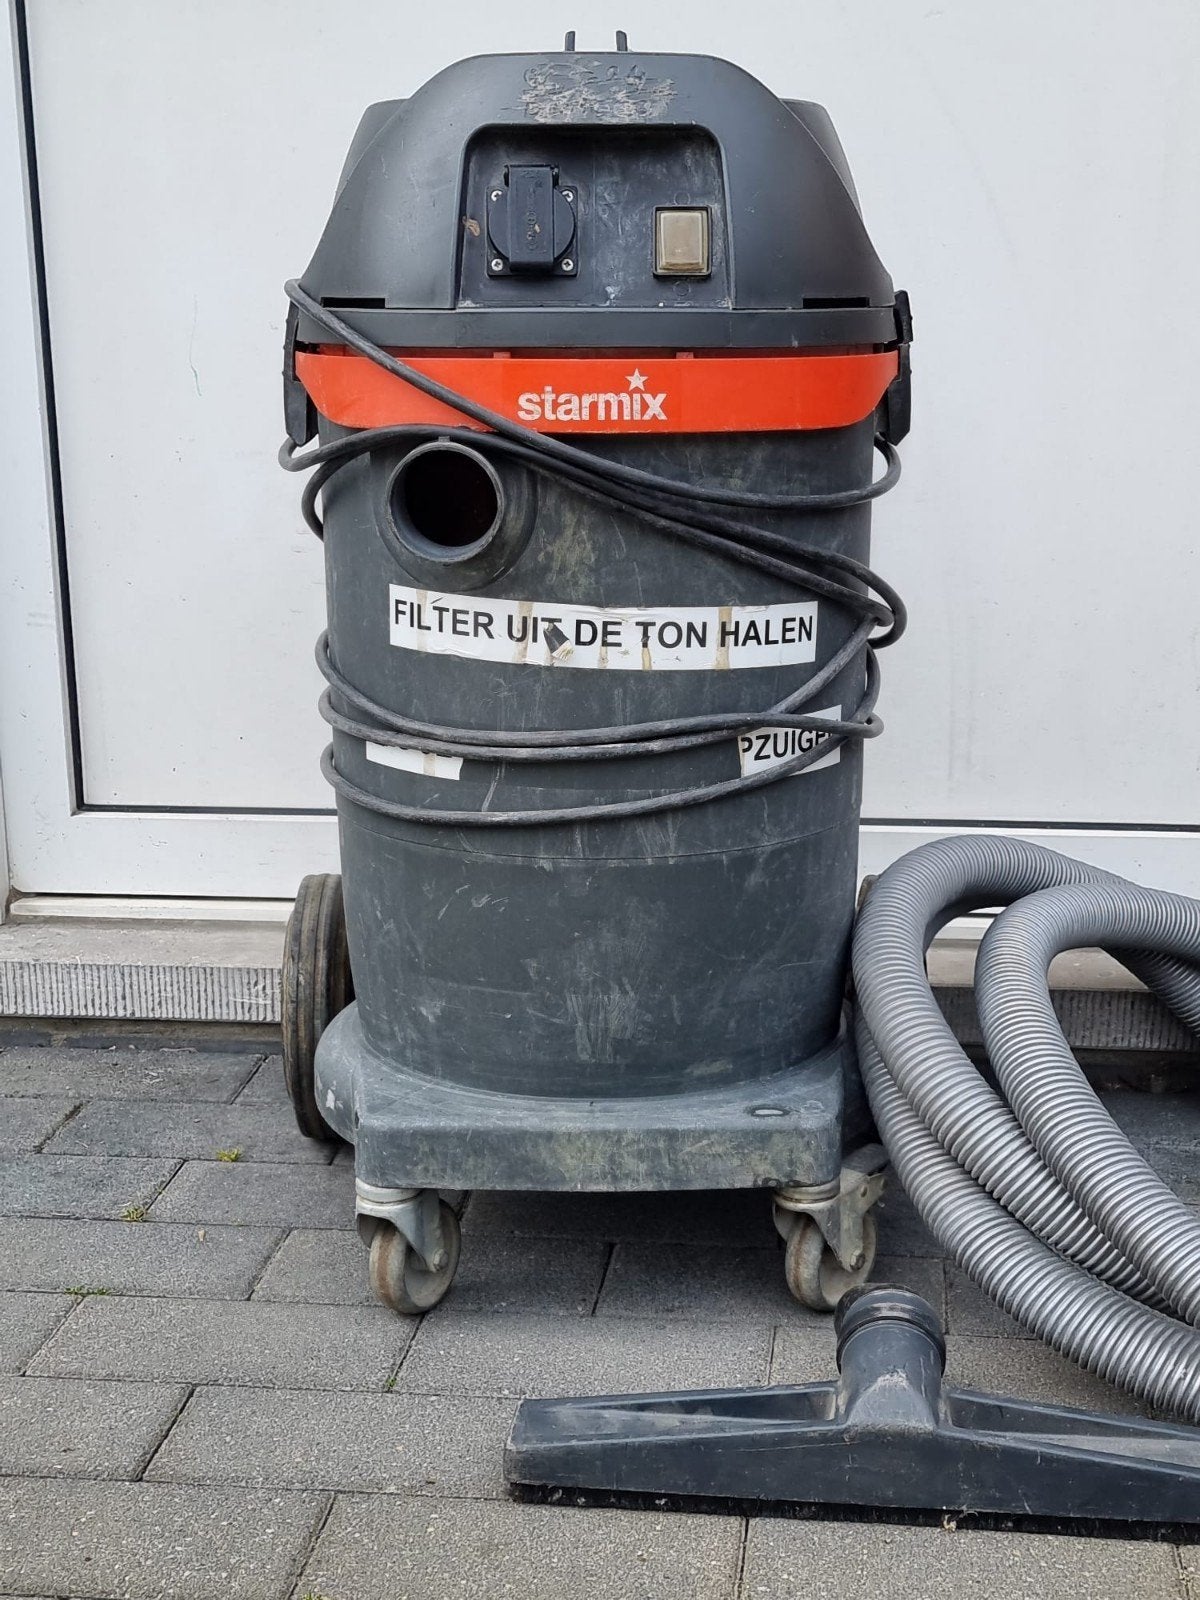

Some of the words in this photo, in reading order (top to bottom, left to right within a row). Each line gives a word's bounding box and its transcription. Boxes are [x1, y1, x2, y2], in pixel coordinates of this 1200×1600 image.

[517, 368, 668, 421] starmix
[394, 599, 495, 640] FILTER
[575, 619, 623, 648] DE
[635, 621, 708, 649] TON
[720, 615, 813, 648] HALEN
